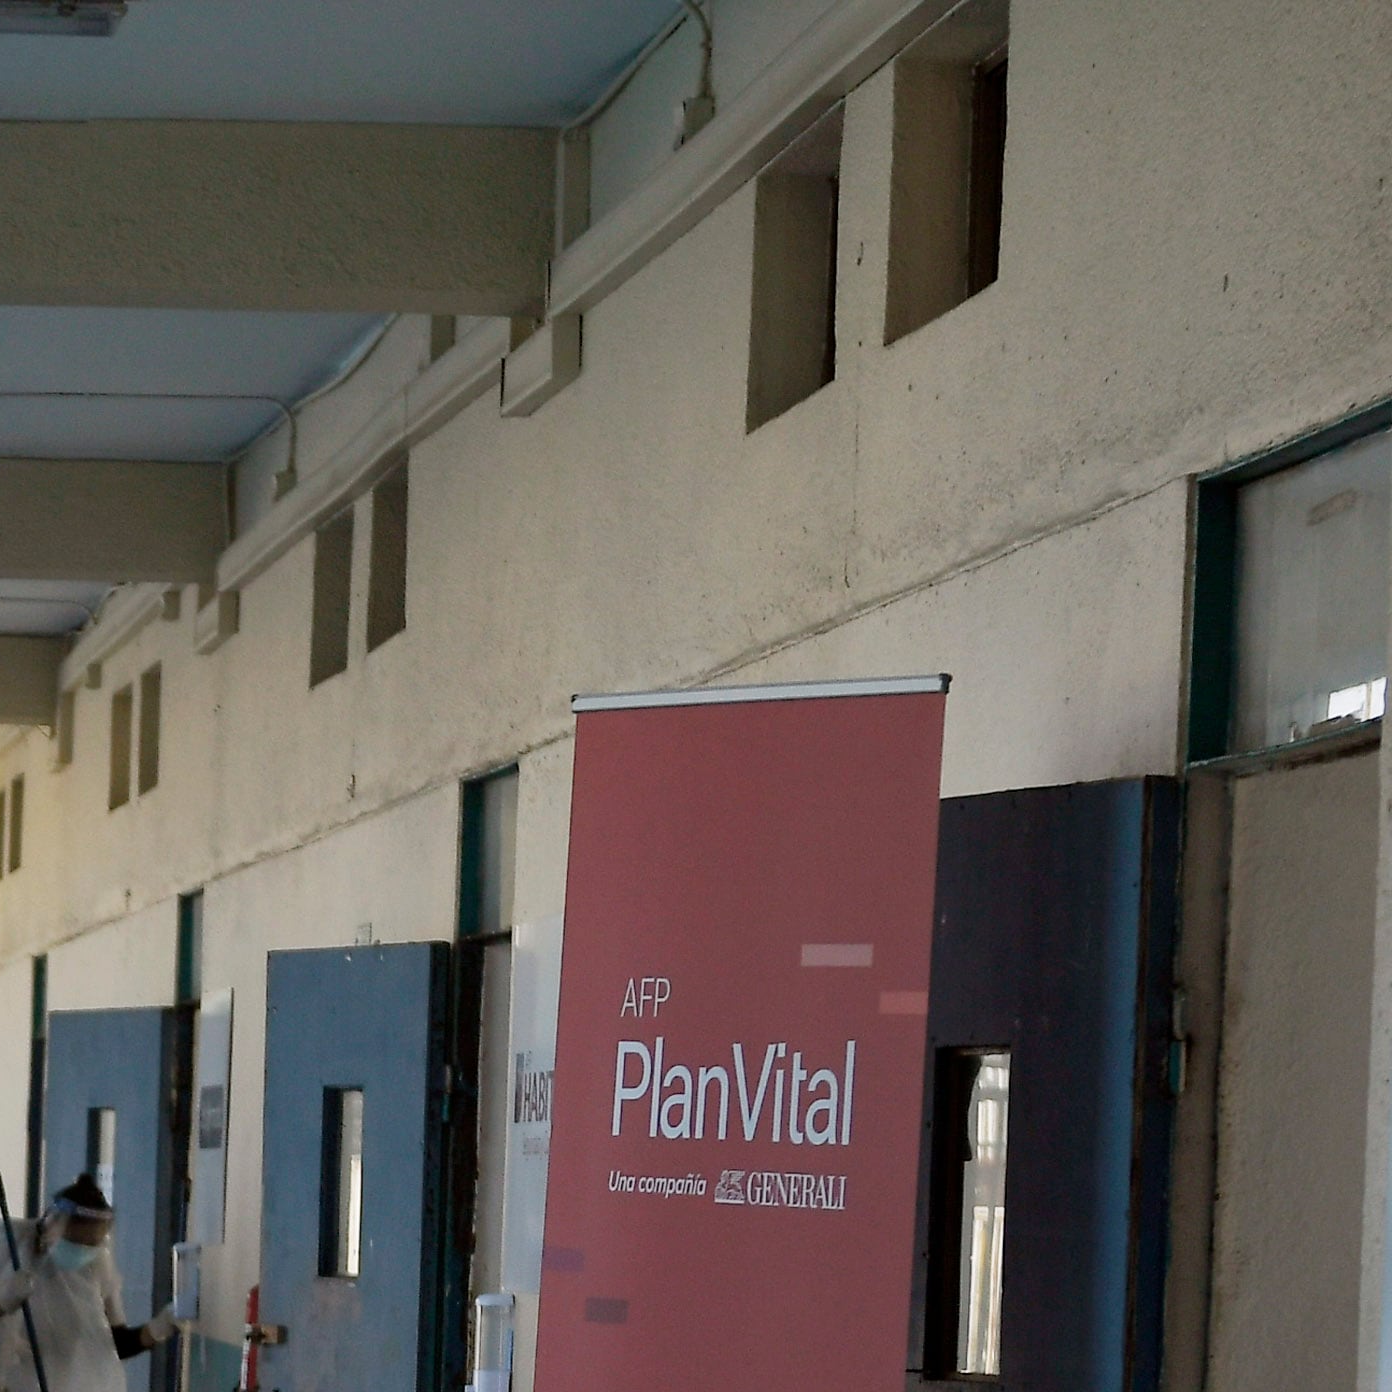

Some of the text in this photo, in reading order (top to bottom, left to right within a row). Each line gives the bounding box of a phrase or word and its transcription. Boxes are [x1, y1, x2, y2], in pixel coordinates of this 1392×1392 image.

[620, 976, 672, 1018] AFP
[611, 1036, 857, 1146] PlanVital
[608, 1169, 848, 1210] Una compañía GENERALI
